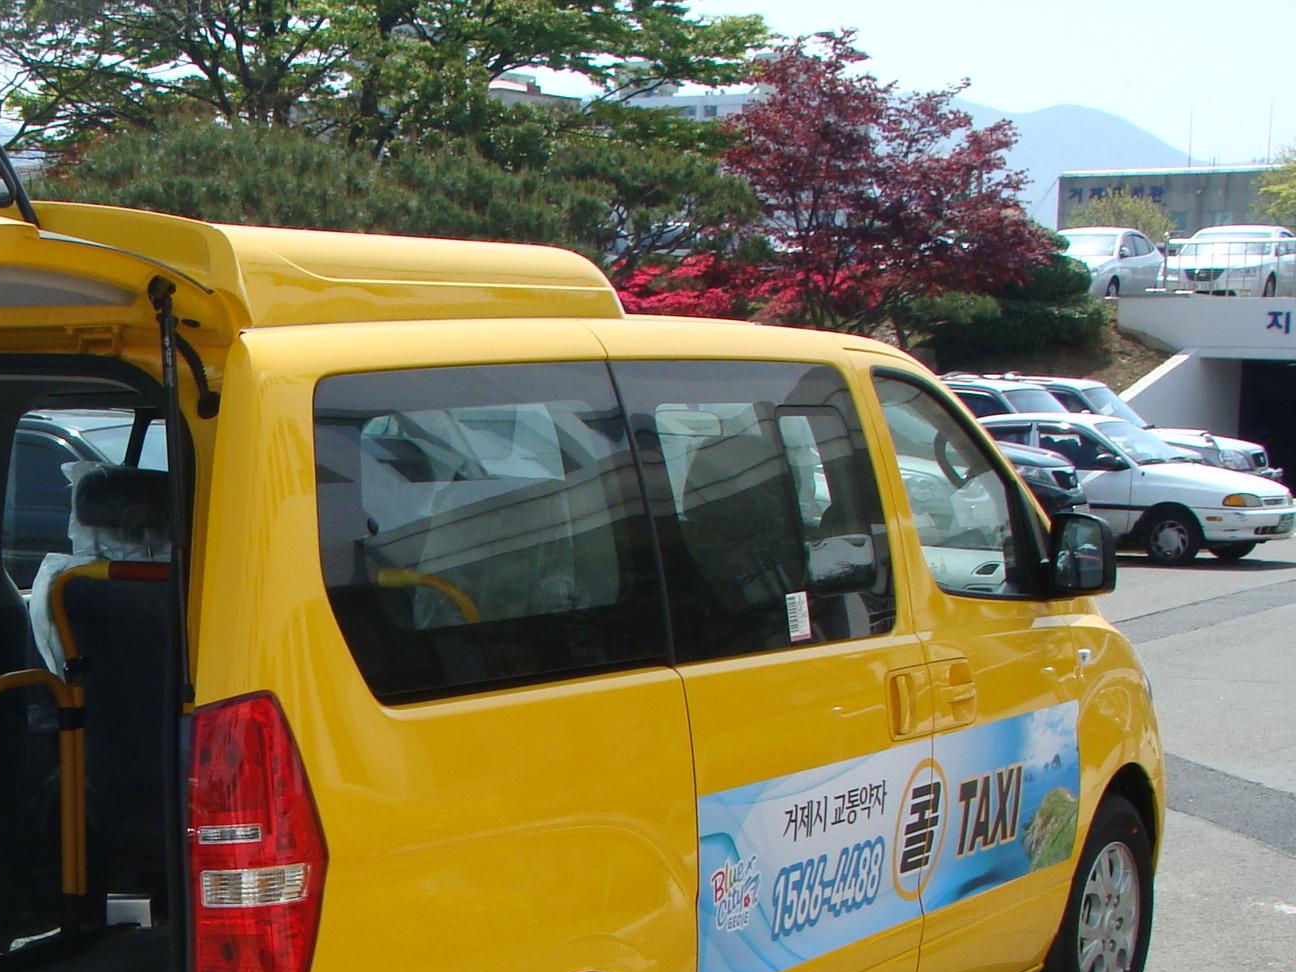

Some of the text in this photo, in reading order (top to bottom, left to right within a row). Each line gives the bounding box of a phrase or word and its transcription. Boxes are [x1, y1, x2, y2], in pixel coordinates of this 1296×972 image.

[1266, 311, 1291, 335] 지
[783, 779, 888, 842] 거제시 교통약자
[900, 763, 1023, 874] 콜 TAXI
[712, 861, 744, 903] Blue
[771, 836, 885, 941] 1566-4488
